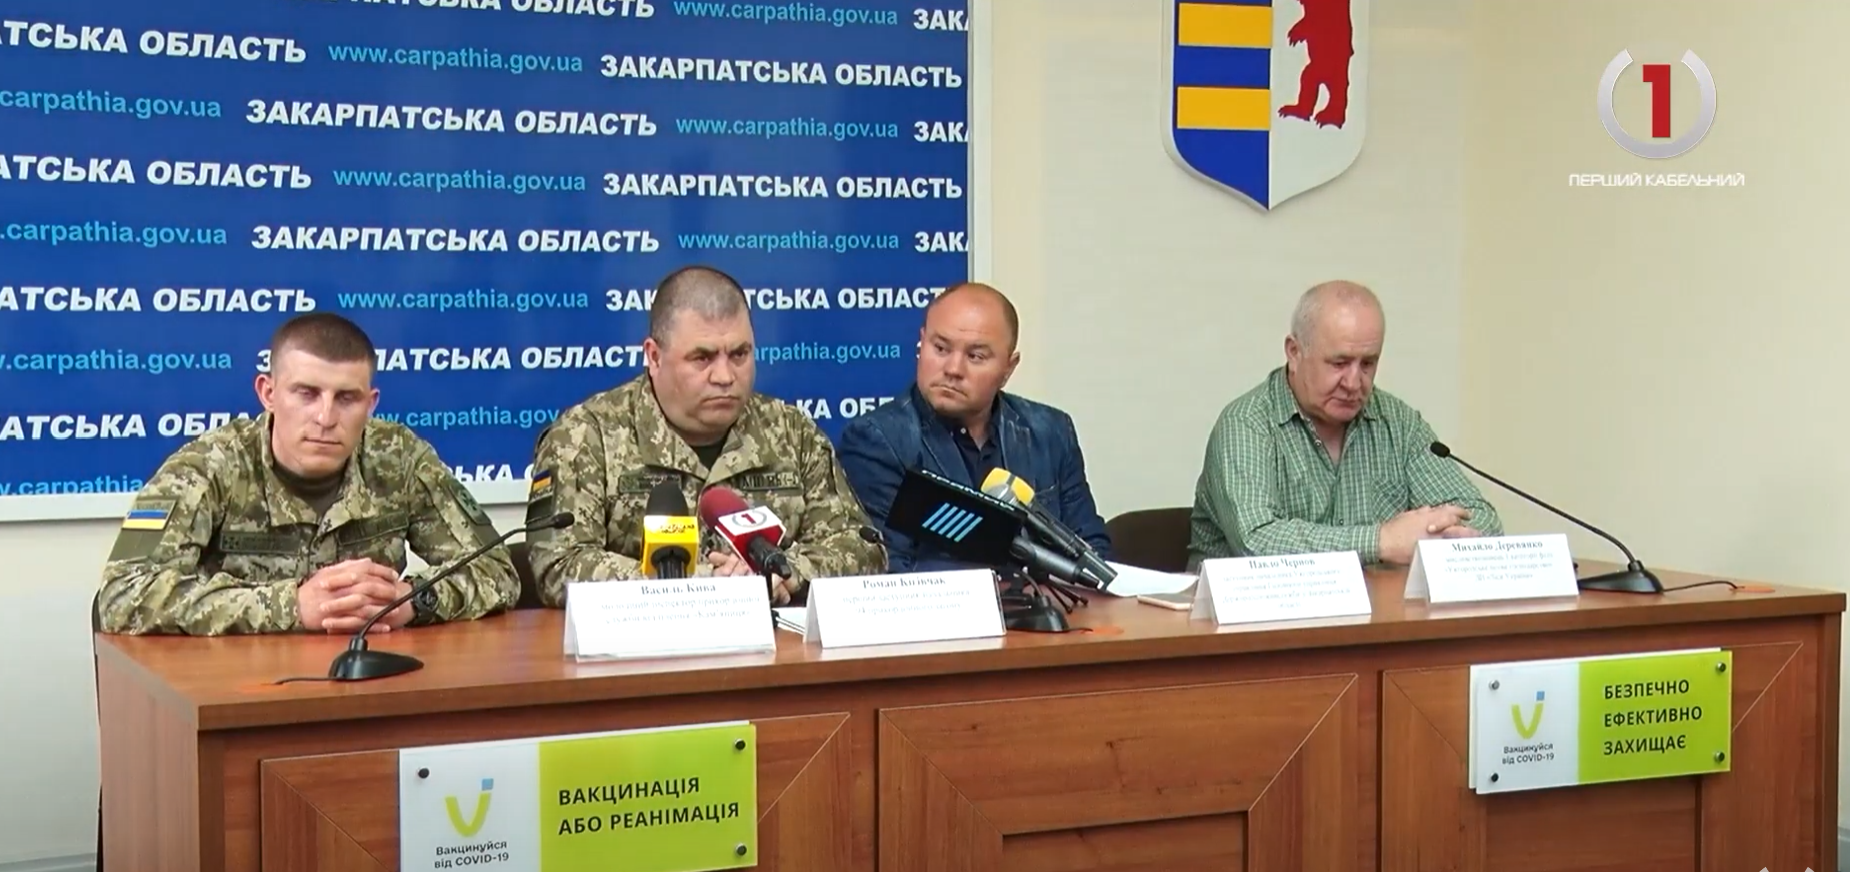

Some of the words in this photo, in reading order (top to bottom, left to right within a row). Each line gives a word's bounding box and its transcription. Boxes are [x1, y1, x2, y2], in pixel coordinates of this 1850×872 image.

[674, 1, 897, 27] www.carpathia.gov.ua
[0, 21, 127, 52] ТСЬКА
[140, 31, 305, 62] ОБЛАСТЬ
[329, 46, 582, 74] www.carpathia.gov.ua
[601, 55, 827, 84] ЗАКАРПАТСЬКА
[836, 64, 961, 87] ОБЛАСТЬ
[246, 100, 504, 131] ЗАКАРПАТСЬКА
[515, 111, 656, 135] ОБЛАСТЬ
[676, 117, 897, 141] www.carpathia.gov.ua
[147, 161, 311, 188] ОБЛАСТЬ
[333, 169, 585, 194] www.carpathia.gov.ua
[604, 173, 828, 197] ЗАКАРПАТСЬКА
[837, 177, 962, 198] ОБЛАСТЬ
[252, 226, 507, 251] ЗАКАРПАТСЬКА
[518, 230, 659, 252] ОБЛАСТЬ
[678, 230, 898, 253] www.carpathia.gov.ua
[153, 288, 315, 311] ОБЛАСТЬ
[338, 289, 588, 312] www.carpathia.gov.ua
[838, 288, 946, 308] ОБЛАСТ
[522, 346, 648, 367] ОБЛАСТ
[741, 513, 756, 525] 1
[1604, 679, 1690, 699] БЕЗПЕЧНО
[1604, 706, 1702, 727] ЕФЕКТИВНО
[1503, 742, 1553, 755] Вакцинуйся
[1603, 735, 1686, 755] ЗАХИЩАЄ
[1502, 755, 1515, 765] від
[1517, 753, 1554, 764] COVID-19
[559, 777, 700, 806] ВАКЦИНАЦІЯ
[558, 814, 602, 836] АБО
[611, 802, 739, 831] РЕАНІМАЦІЯ
[435, 840, 507, 856] Вакцинуйся
[434, 858, 452, 869] від
[455, 853, 509, 867] COVID-19
